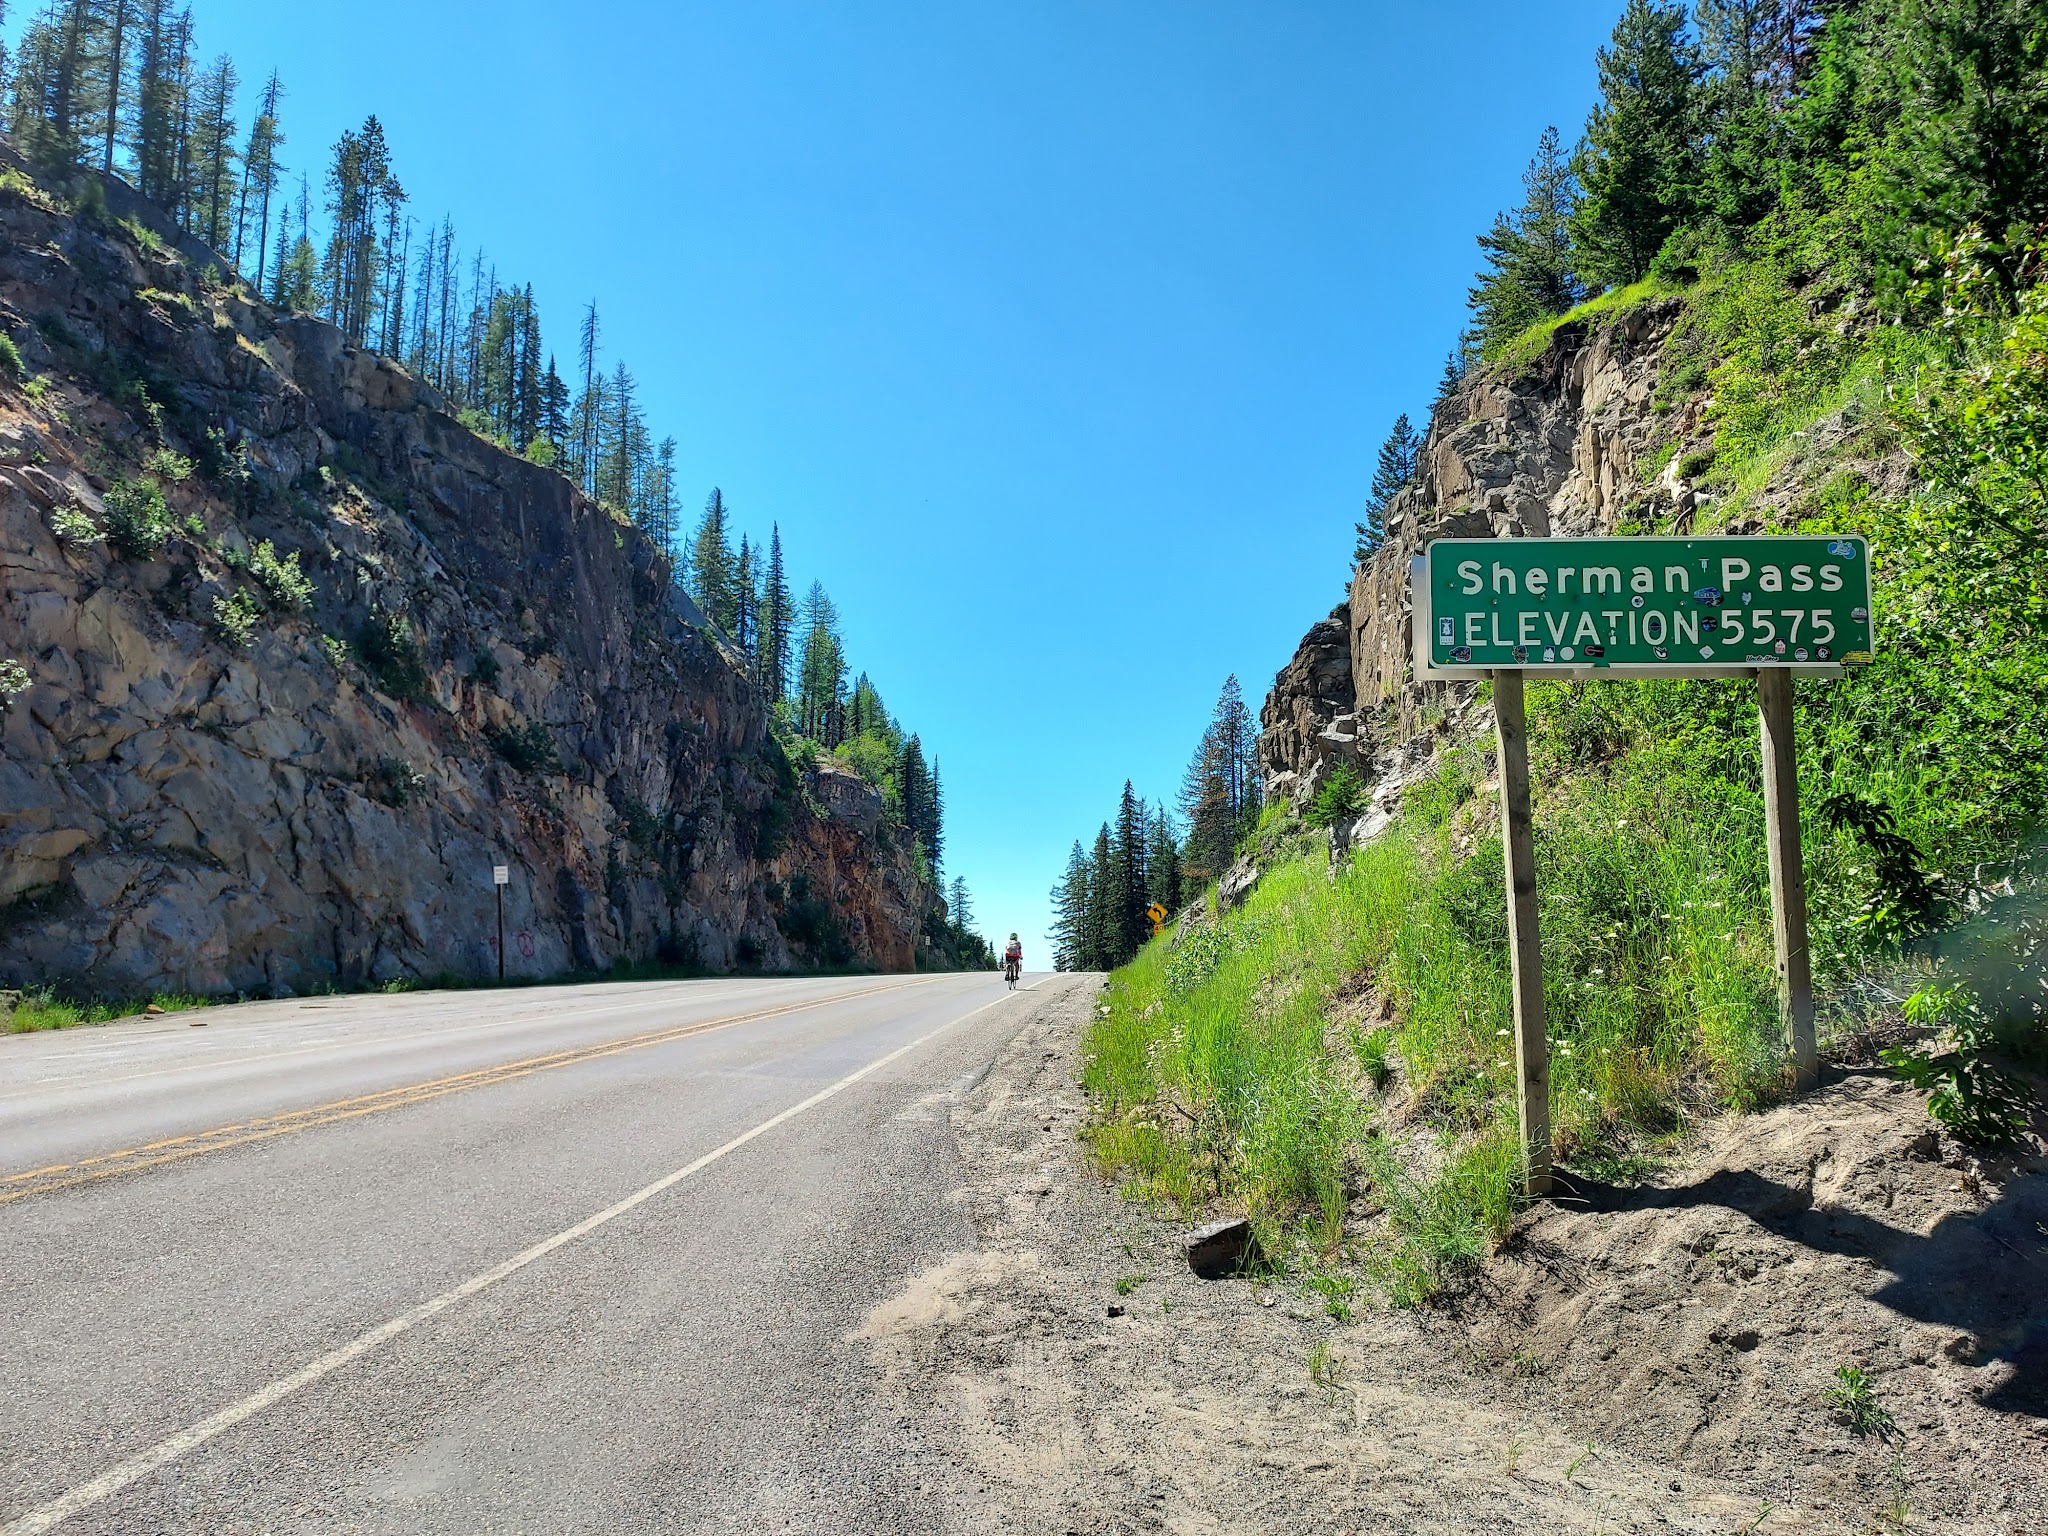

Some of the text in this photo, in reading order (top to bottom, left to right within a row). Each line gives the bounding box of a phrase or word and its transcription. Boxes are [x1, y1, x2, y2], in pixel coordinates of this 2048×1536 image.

[1457, 558, 1843, 594] Sherman Pass
[1465, 610, 1835, 646] ELEVATION 5575
